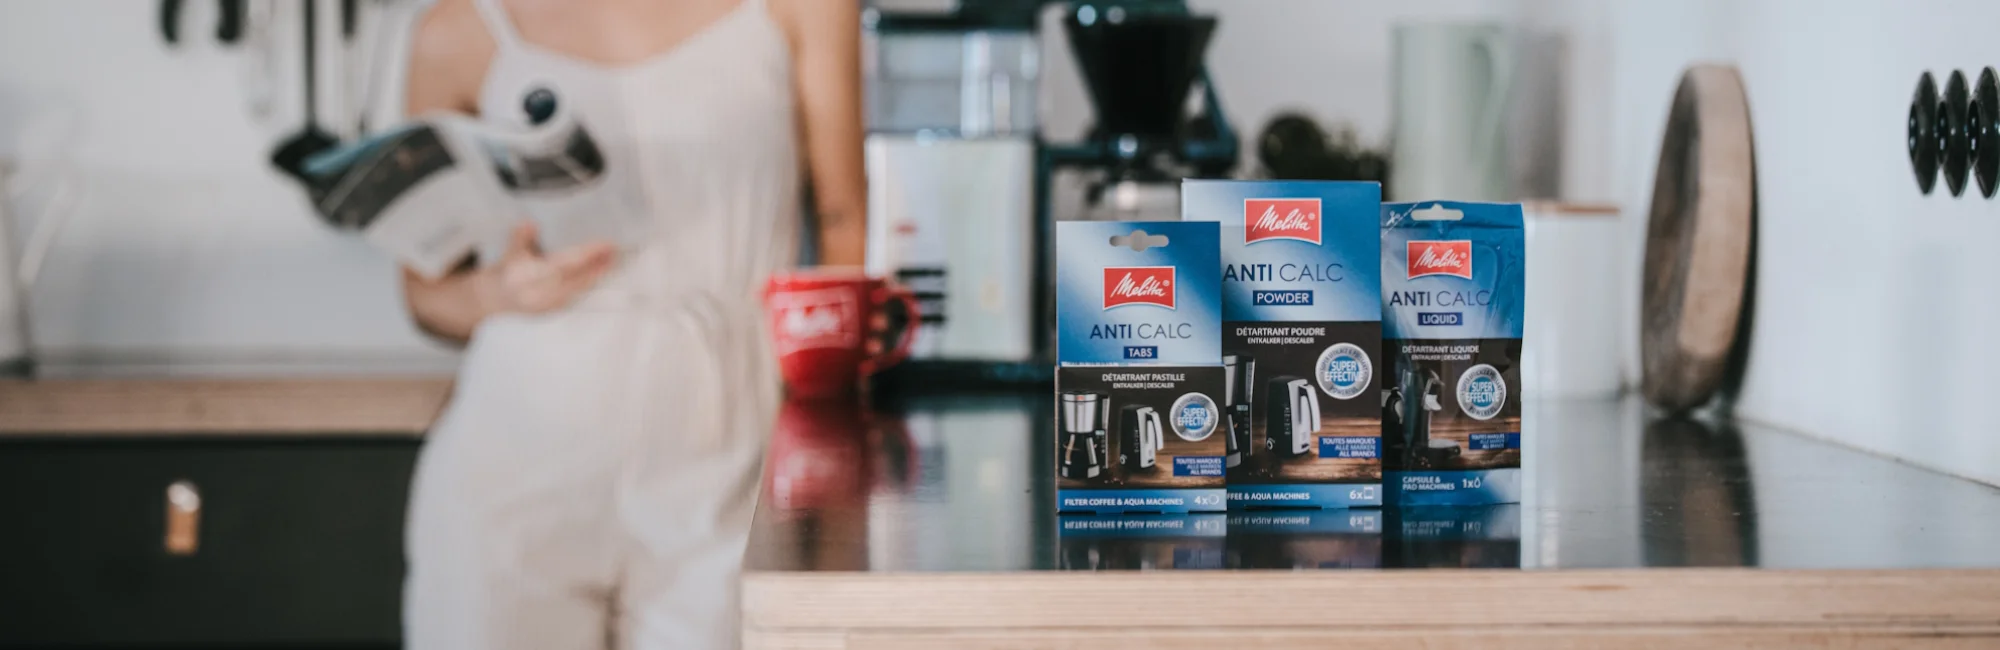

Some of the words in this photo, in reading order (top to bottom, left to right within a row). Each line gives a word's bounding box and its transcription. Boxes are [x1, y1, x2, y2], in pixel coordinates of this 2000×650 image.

[1223, 264, 1272, 282] ANTI
[1279, 263, 1343, 282] CALC
[1256, 292, 1310, 304] POWDER
[1389, 291, 1431, 306] ANTI
[1436, 290, 1491, 307] CALC
[1422, 314, 1458, 325] LIQUID
[1090, 324, 1132, 339] ANTI
[1137, 323, 1192, 339] CALC
[1236, 326, 1290, 336] DÉTARTRANT
[1291, 327, 1326, 336] POUDRE
[1128, 347, 1153, 357] TABS
[1450, 345, 1480, 353] LIQUIDE
[1331, 360, 1358, 372] SUPER
[1102, 372, 1151, 382] DÉTARTRANT
[1152, 373, 1186, 382] PASTILLE
[1324, 371, 1364, 382] EFFECTIVE
[1471, 381, 1493, 392] SUPER
[1465, 391, 1500, 403] EFFECTIVE
[1183, 407, 1206, 417] SUPER
[1402, 476, 1435, 484] CAPSULE
[1402, 483, 1419, 491] PAD
[1419, 483, 1455, 491] MACHINES
[1244, 492, 1250, 500] &
[1251, 492, 1272, 501] AQUA
[1272, 492, 1311, 500] MACHINES
[1064, 498, 1088, 506] FILTER
[1088, 498, 1116, 506] COFFEE
[1117, 498, 1123, 506] &
[1123, 498, 1145, 507] AQUA
[1145, 498, 1184, 506] MACHINES
